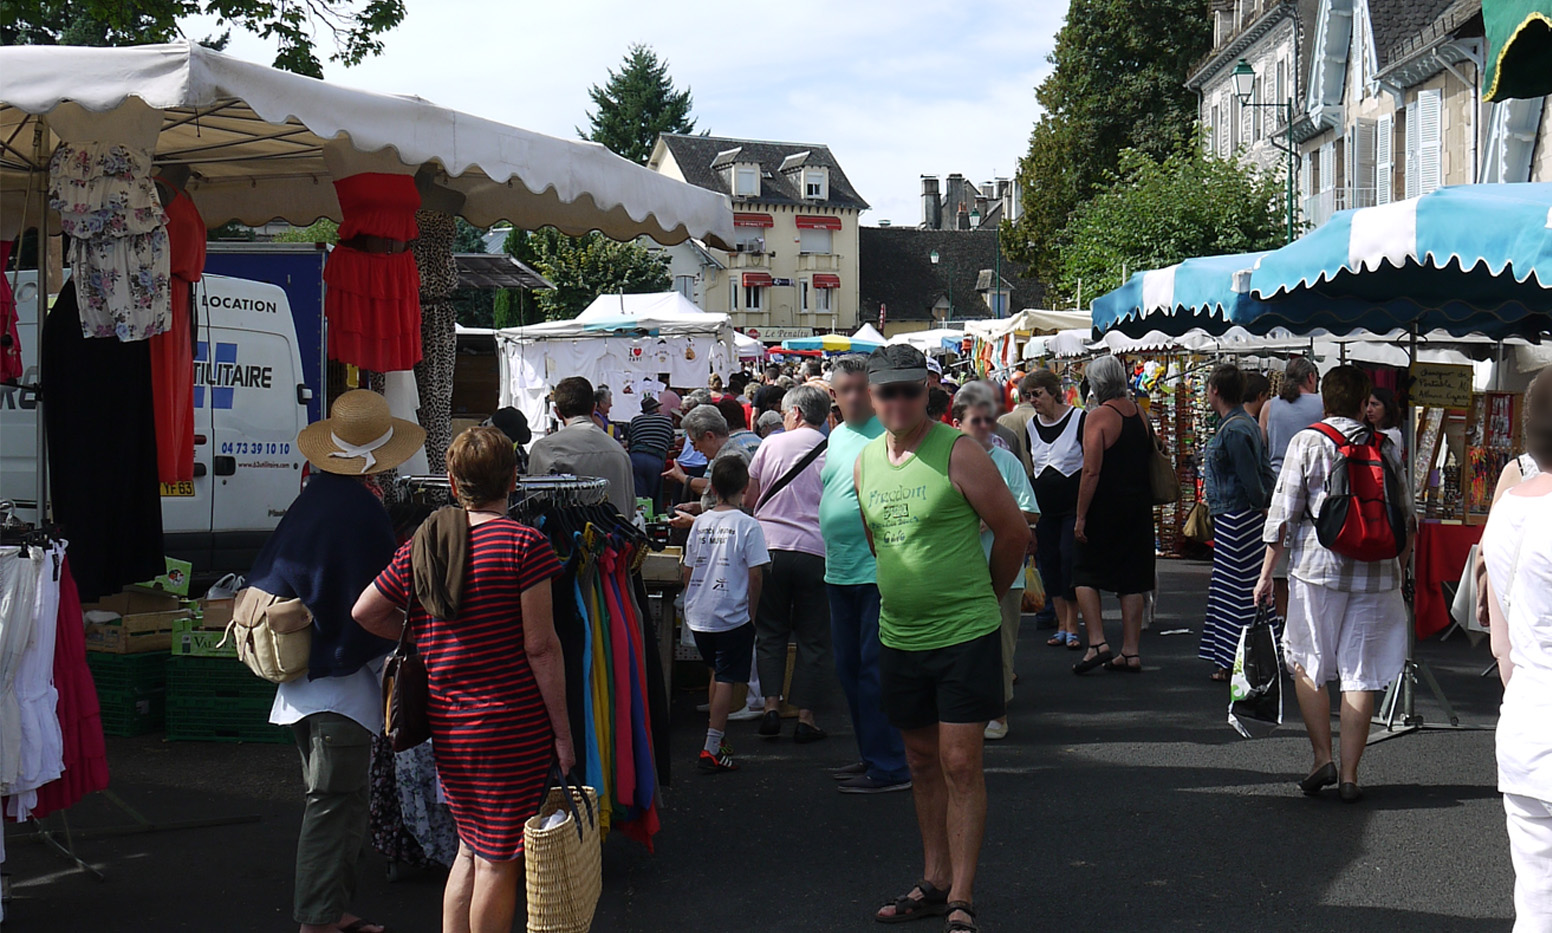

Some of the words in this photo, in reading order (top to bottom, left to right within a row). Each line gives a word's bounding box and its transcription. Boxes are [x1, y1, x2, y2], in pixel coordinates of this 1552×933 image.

[202, 295, 277, 314] LOCATION
[765, 330, 774, 338] Le
[777, 329, 809, 338] Penalty
[222, 442, 233, 454] 04
[236, 443, 248, 454] 73
[251, 443, 263, 455] 39
[266, 443, 276, 455] 10
[279, 443, 290, 455] 10
[178, 480, 192, 495] 63
[868, 484, 927, 508] Freedom
